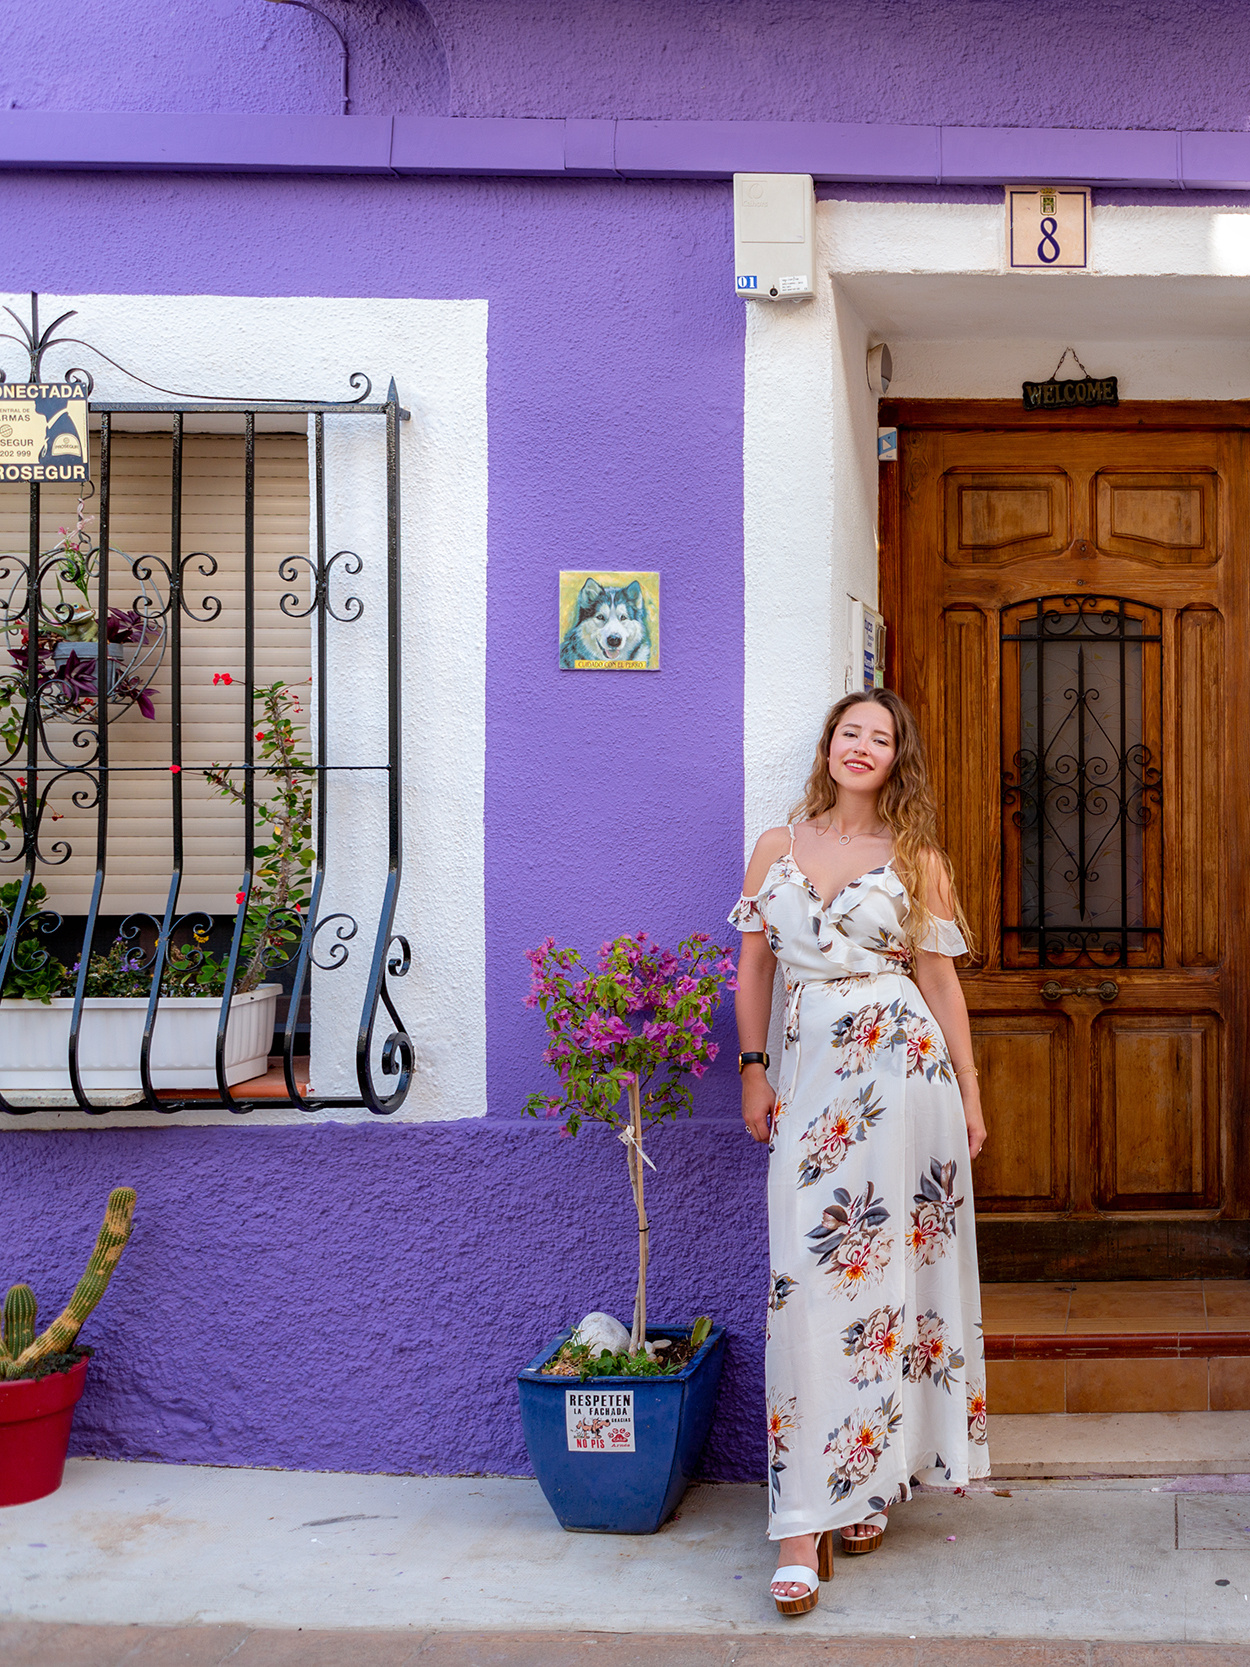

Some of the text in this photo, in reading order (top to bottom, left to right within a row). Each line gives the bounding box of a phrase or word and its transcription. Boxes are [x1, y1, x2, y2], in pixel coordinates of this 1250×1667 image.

[1037, 217, 1060, 263] 8
[738, 276, 756, 288] 01
[0, 385, 84, 399] NECTADA
[1025, 381, 1114, 405] WELCOME
[569, 1394, 630, 1406] RESPETEN
[589, 1407, 628, 1415] FACHADA
[576, 1439, 605, 1448] NO PIS
